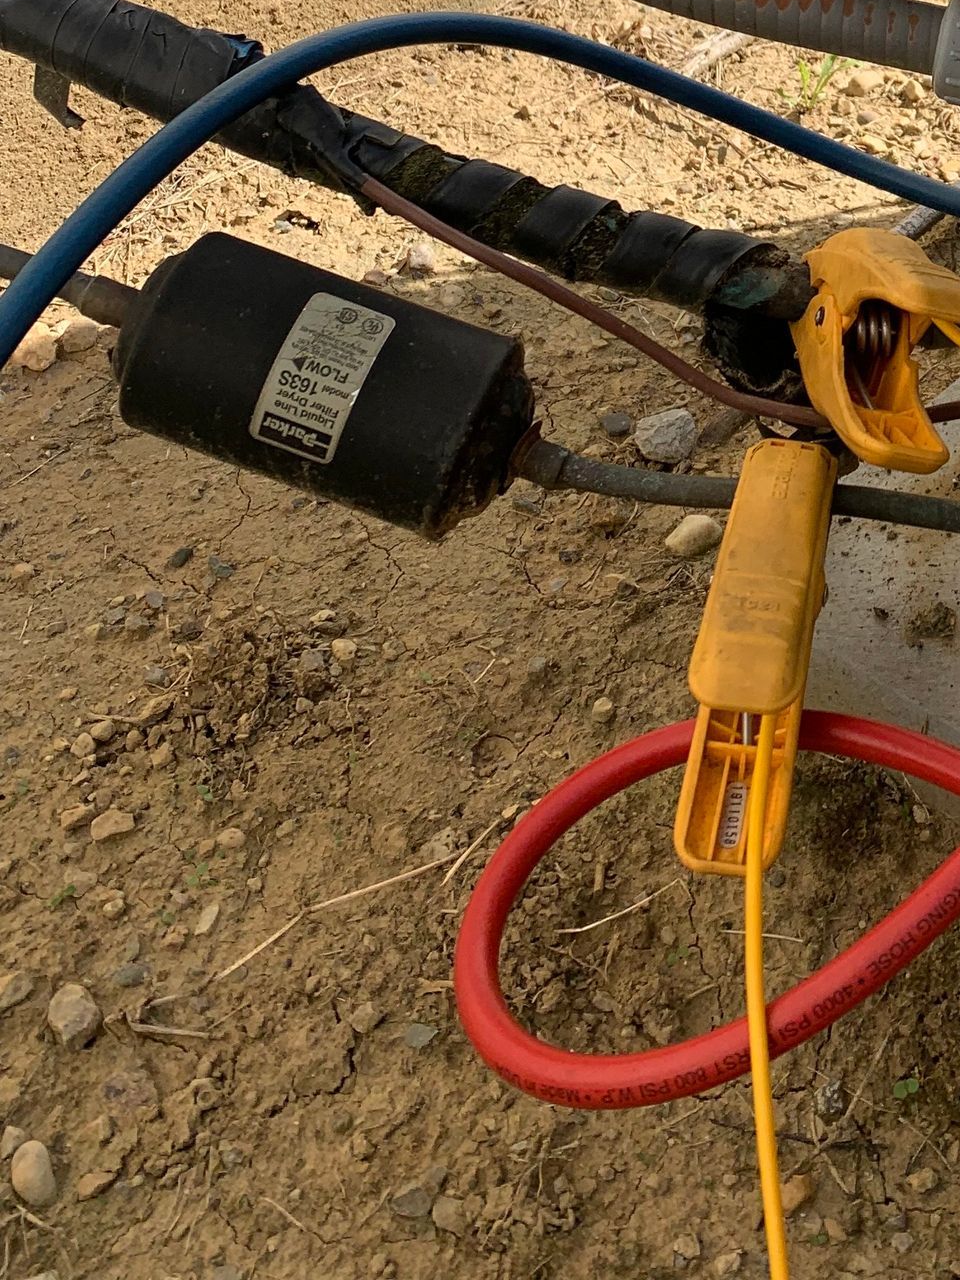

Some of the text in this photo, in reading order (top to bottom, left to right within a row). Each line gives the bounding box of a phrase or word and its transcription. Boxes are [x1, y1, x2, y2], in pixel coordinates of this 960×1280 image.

[278, 369, 350, 400] model 163S
[305, 362, 350, 384] FLOW
[274, 399, 336, 430] Liquid Line
[276, 388, 340, 419] Filter Dryer
[262, 416, 319, 447] Parker
[865, 931, 917, 978] HOSE
[813, 984, 854, 1018] 4000
[778, 1013, 812, 1039] PSI
[640, 1079, 671, 1099] PSI
